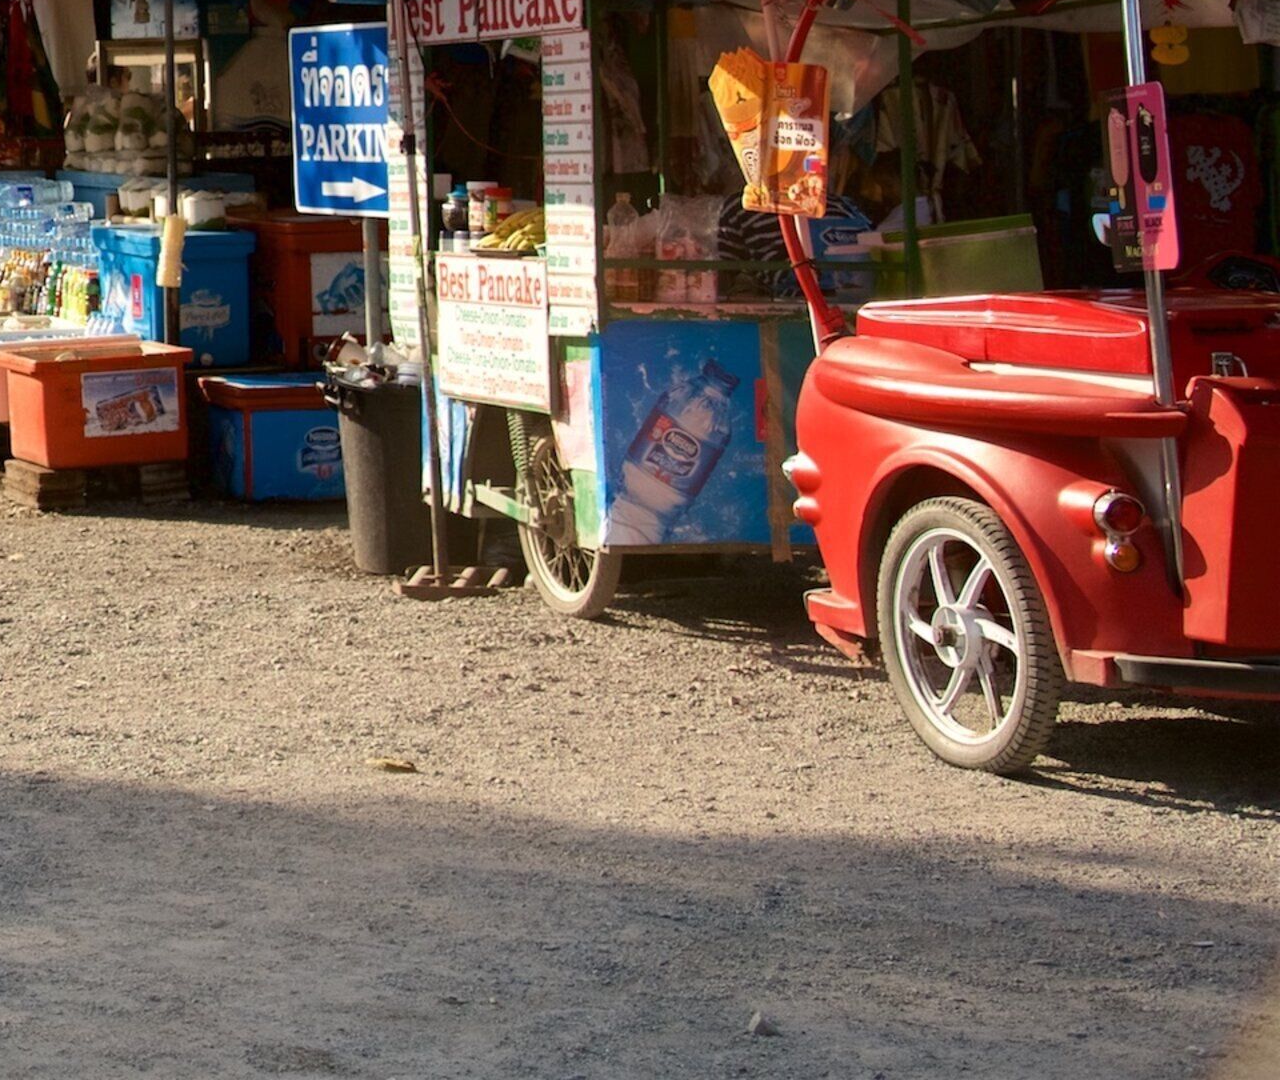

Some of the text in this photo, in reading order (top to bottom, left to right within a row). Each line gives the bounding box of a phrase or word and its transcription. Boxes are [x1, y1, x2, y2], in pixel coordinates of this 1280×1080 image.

[300, 35, 388, 108] ที่จอดร
[300, 123, 388, 163] PARKIN
[439, 262, 541, 305] Best Pancake
